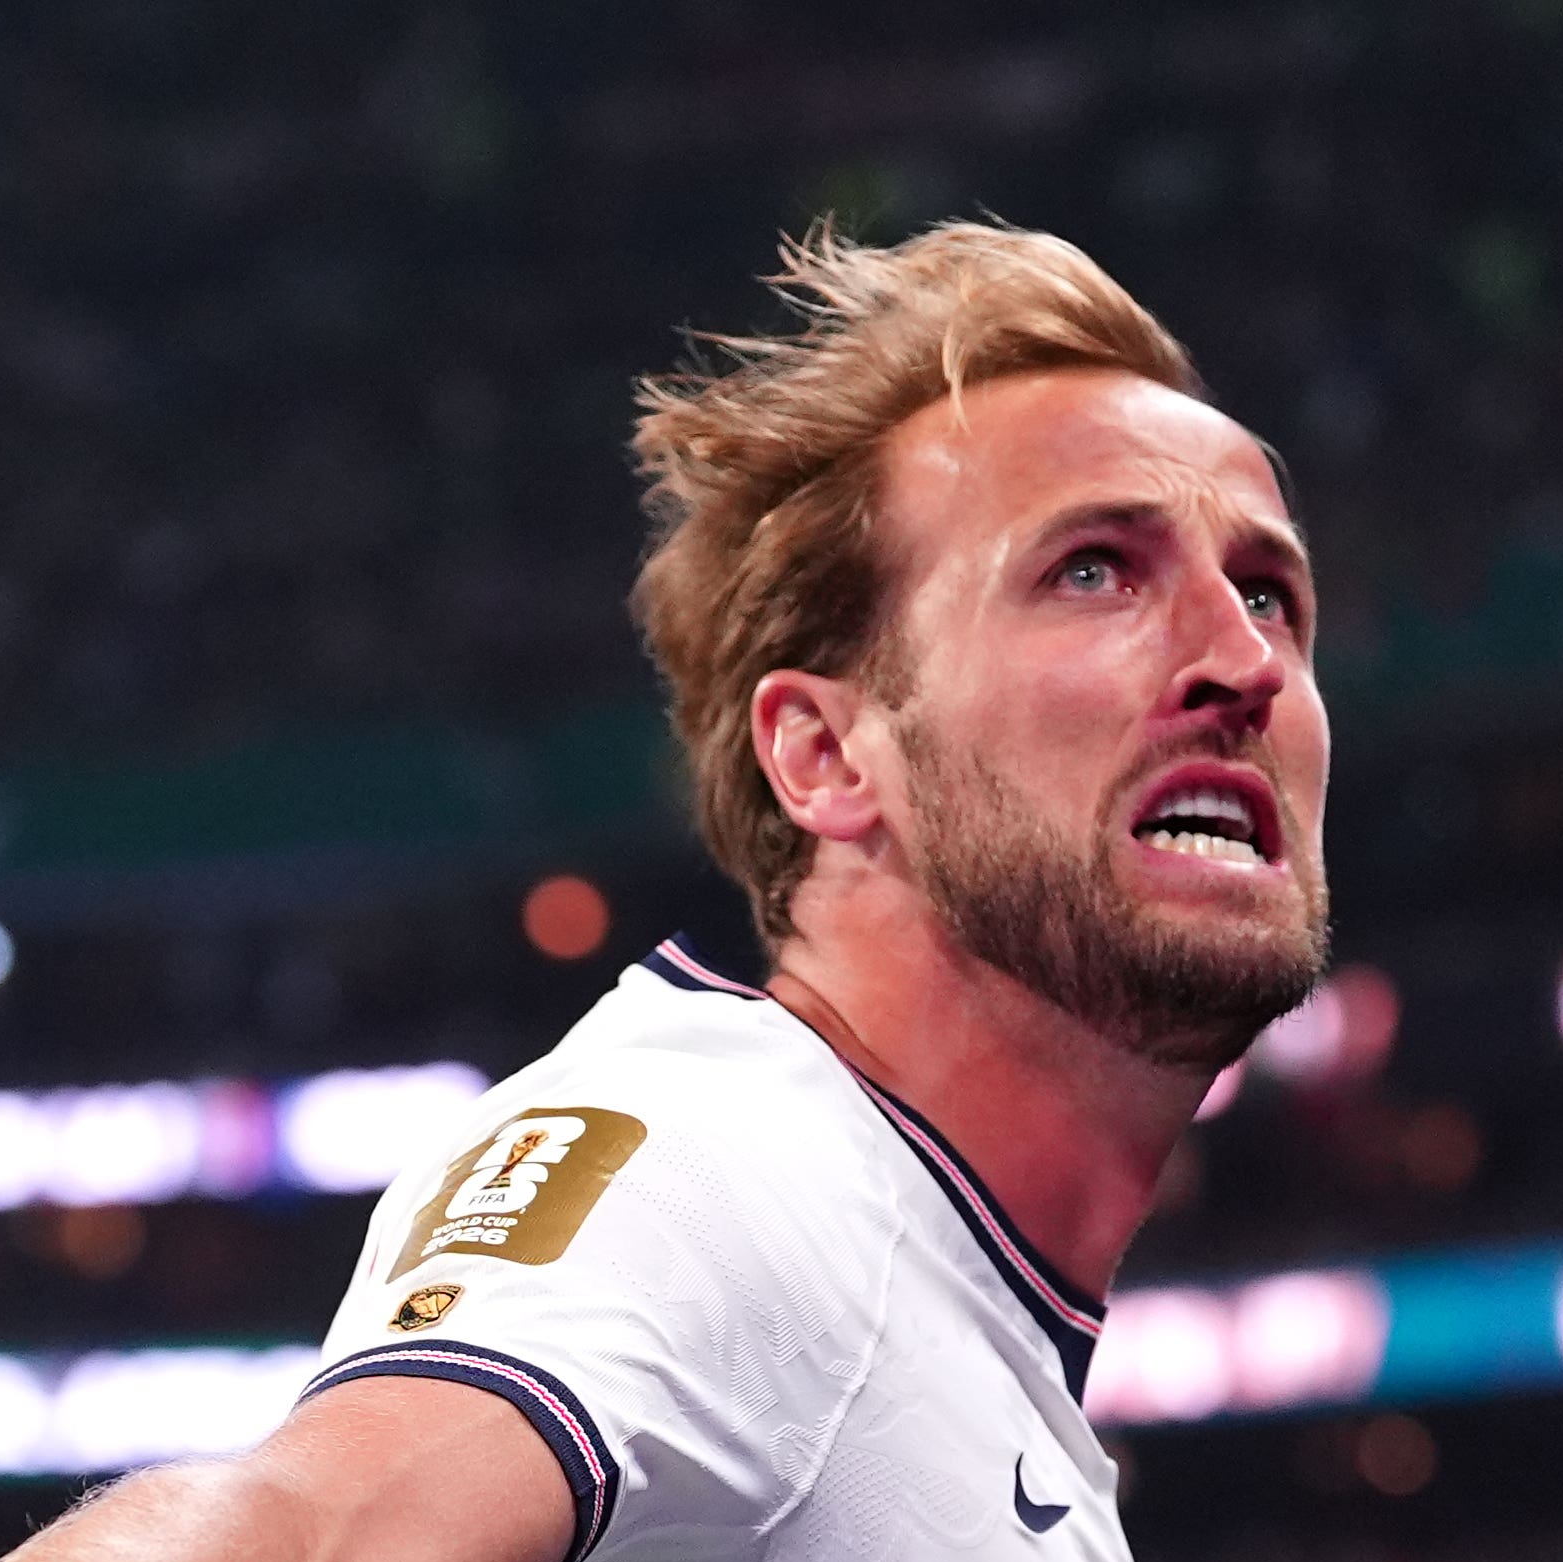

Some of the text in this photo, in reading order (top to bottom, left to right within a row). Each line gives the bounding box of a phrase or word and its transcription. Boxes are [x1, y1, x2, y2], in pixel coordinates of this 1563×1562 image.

[468, 1192, 507, 1206] FIFA
[431, 1216, 519, 1239] WORLD CUP
[420, 1226, 510, 1257] 2026
